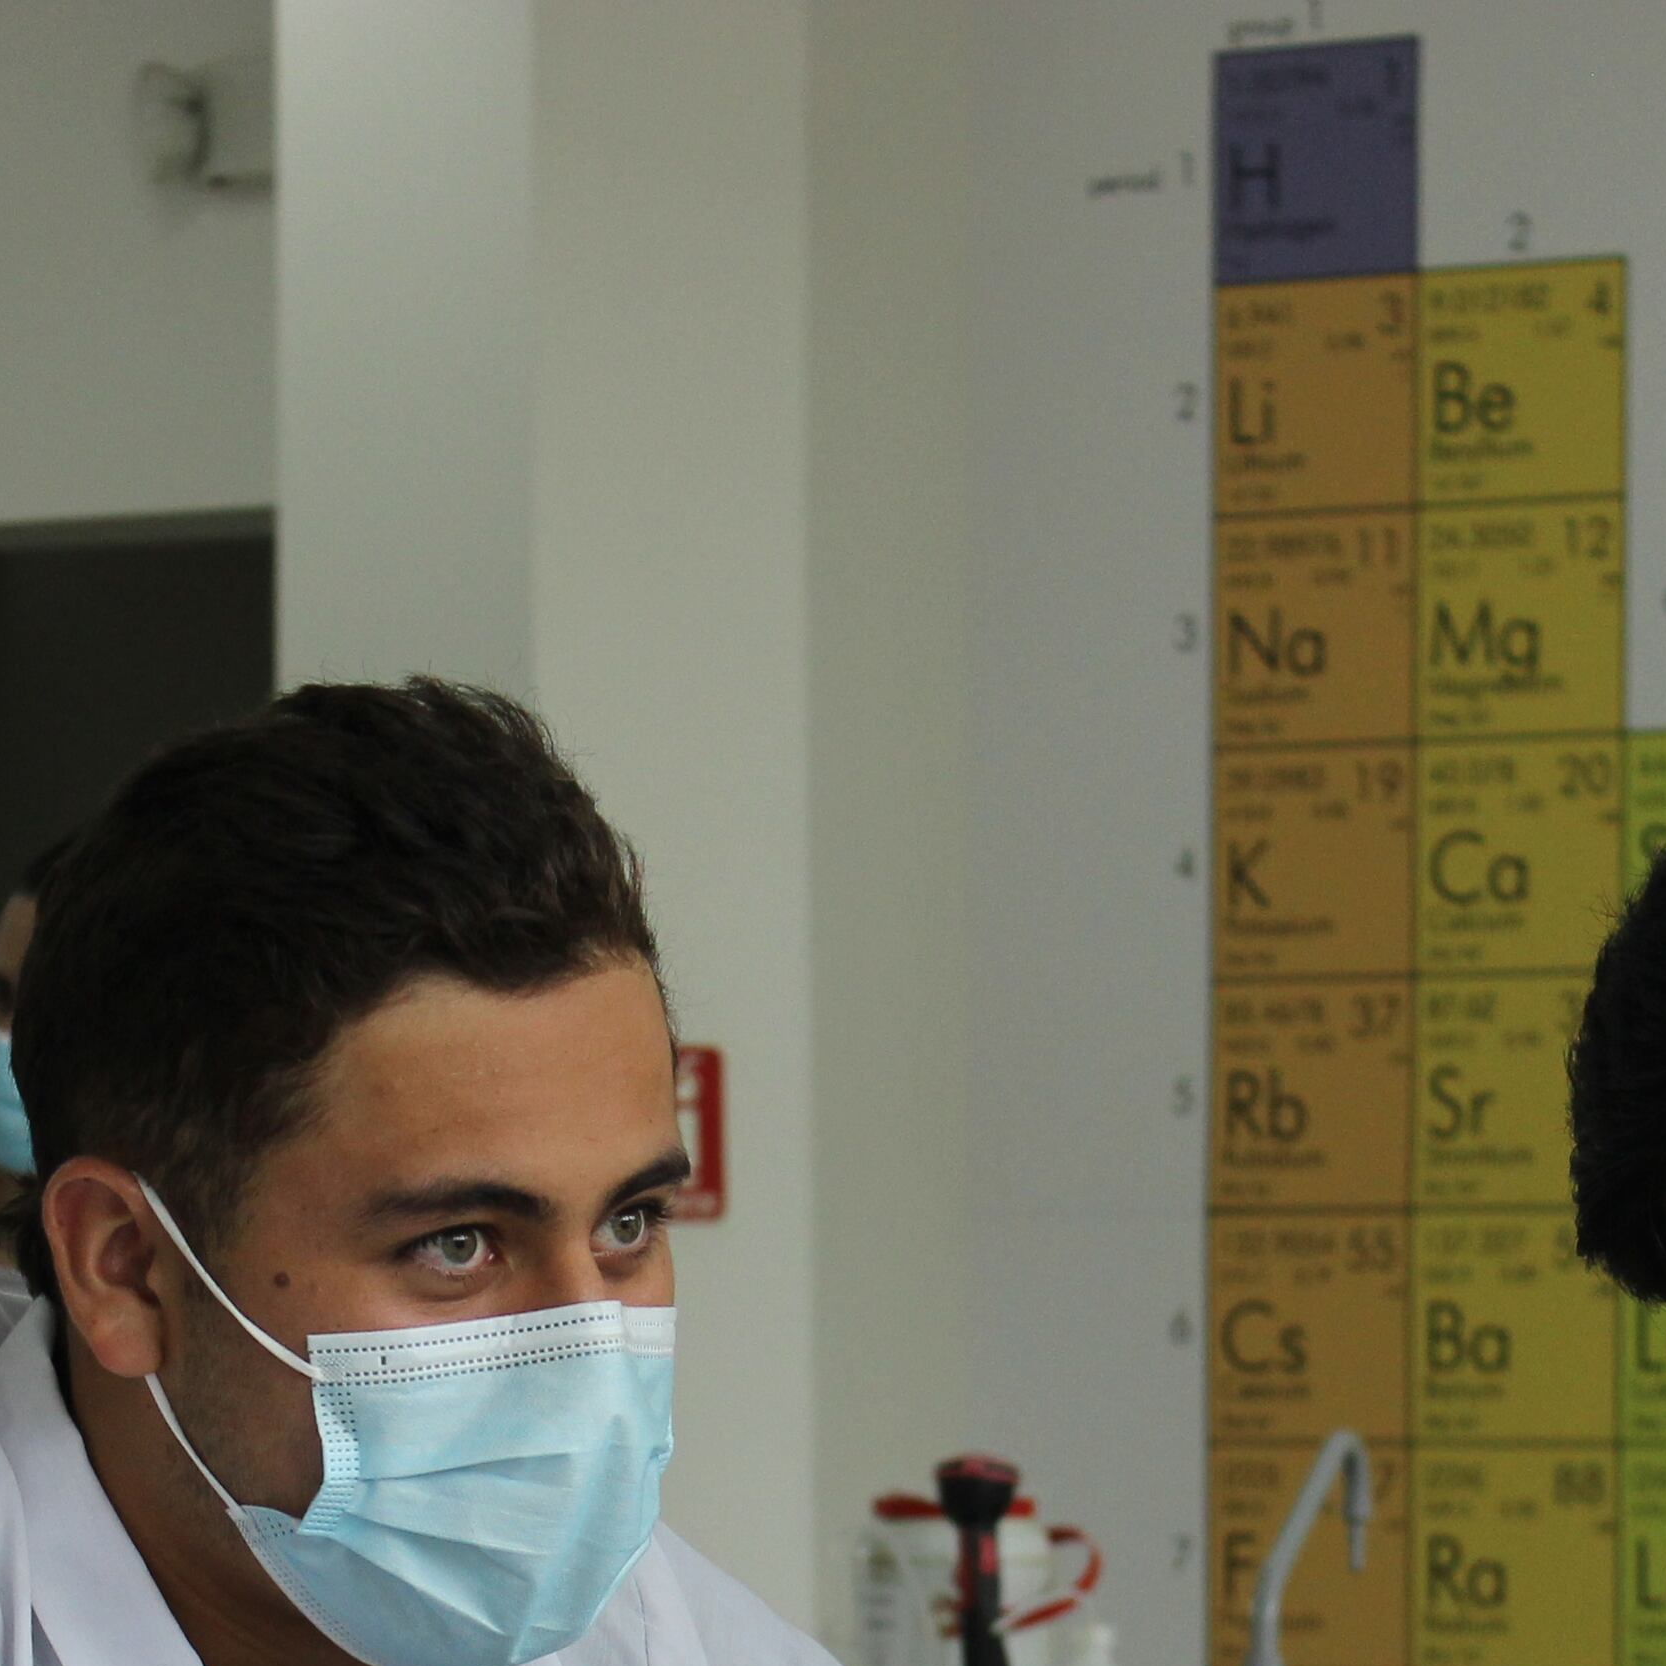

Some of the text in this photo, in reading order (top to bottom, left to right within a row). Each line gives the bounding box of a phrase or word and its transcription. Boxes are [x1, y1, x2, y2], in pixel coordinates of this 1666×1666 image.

[1229, 139, 1282, 210] H
[1227, 377, 1278, 447] Li
[1433, 359, 1517, 436] Be
[1566, 514, 1612, 560] 12
[1226, 606, 1328, 679] Na
[1429, 600, 1541, 688] Mg
[1559, 751, 1612, 798] 20
[1226, 839, 1272, 910] K
[1429, 828, 1531, 906] Ca
[1225, 1067, 1312, 1144] Rb
[1427, 1063, 1496, 1141] Sr
[1347, 1227, 1397, 1272] 55
[1219, 1298, 1310, 1376] Cs
[1426, 1299, 1513, 1375] Ba
[1552, 1464, 1607, 1506] 88
[1222, 1531, 1256, 1604] F
[1425, 1532, 1509, 1607] Ra
